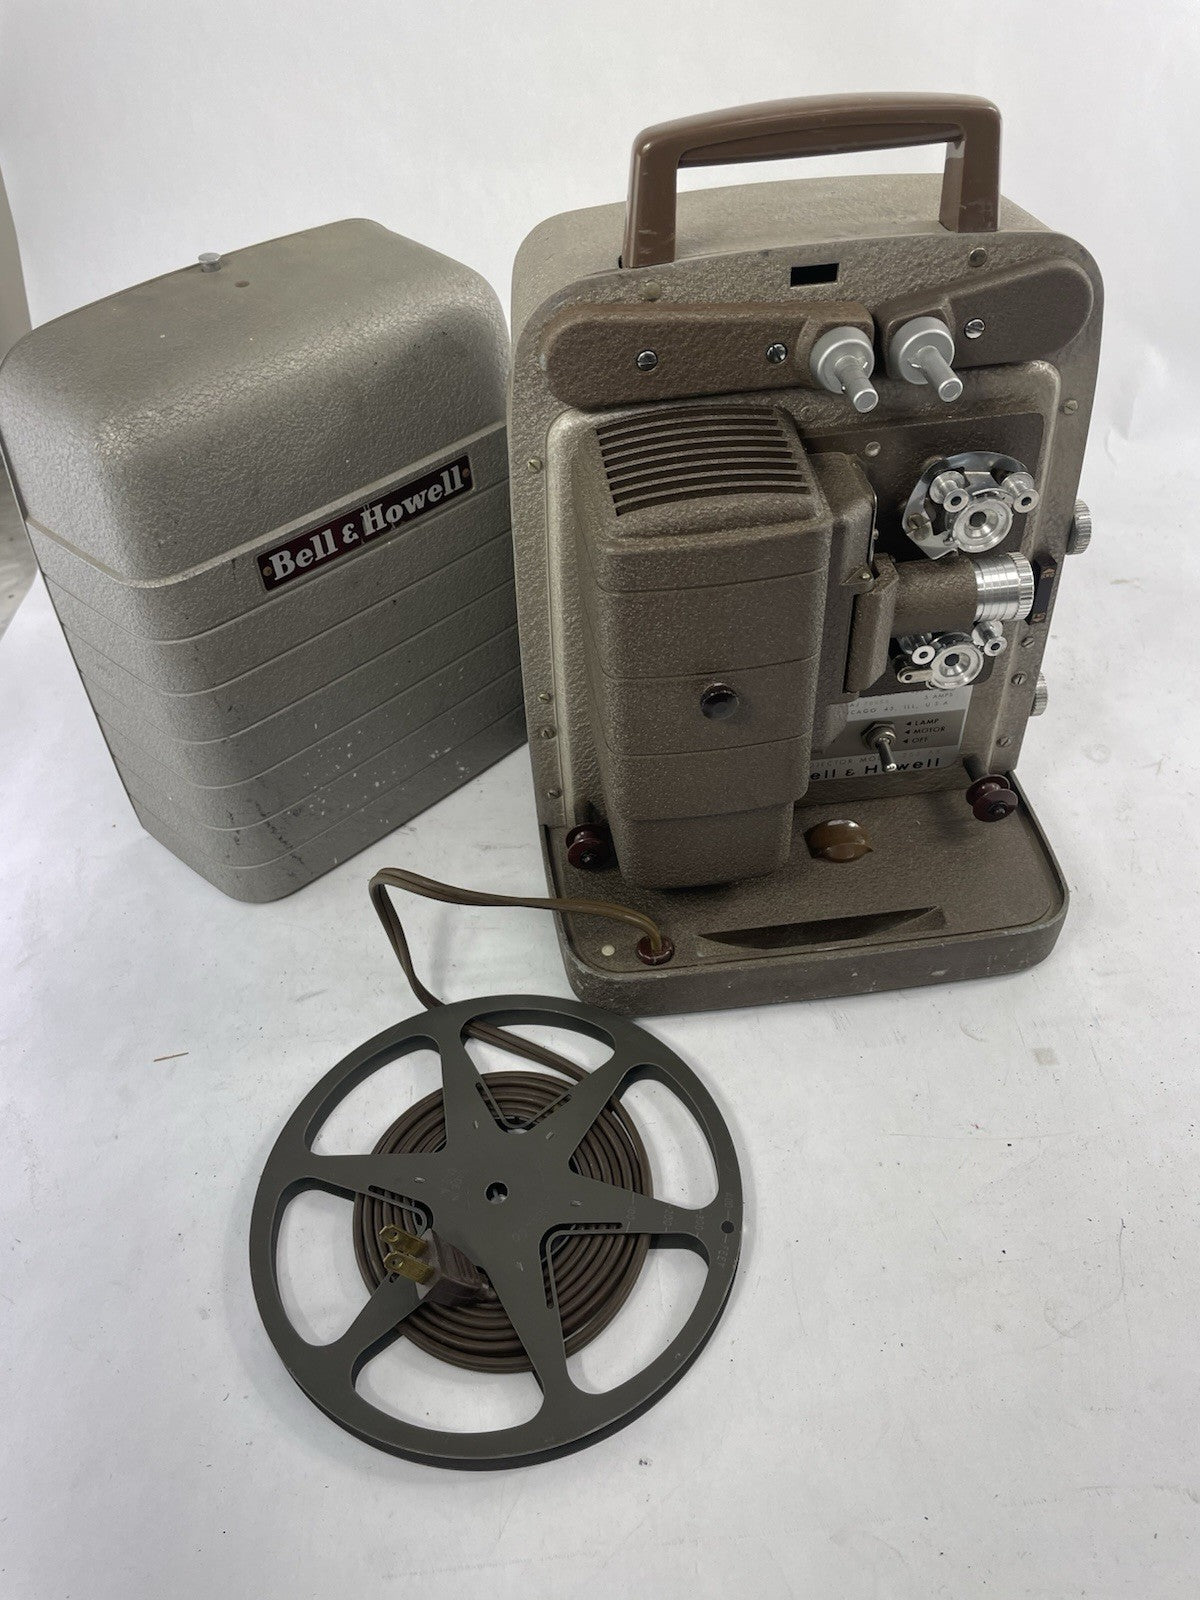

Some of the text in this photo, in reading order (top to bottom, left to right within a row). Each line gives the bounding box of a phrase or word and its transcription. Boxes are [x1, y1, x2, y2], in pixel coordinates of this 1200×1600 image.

[269, 464, 464, 581] Bell & Howell
[914, 718, 940, 727] LAMP
[913, 726, 946, 735] MOTOR
[911, 736, 929, 744] OFF
[810, 768, 836, 780] ell
[845, 769, 856, 777] &
[865, 757, 940, 775] Hwell
